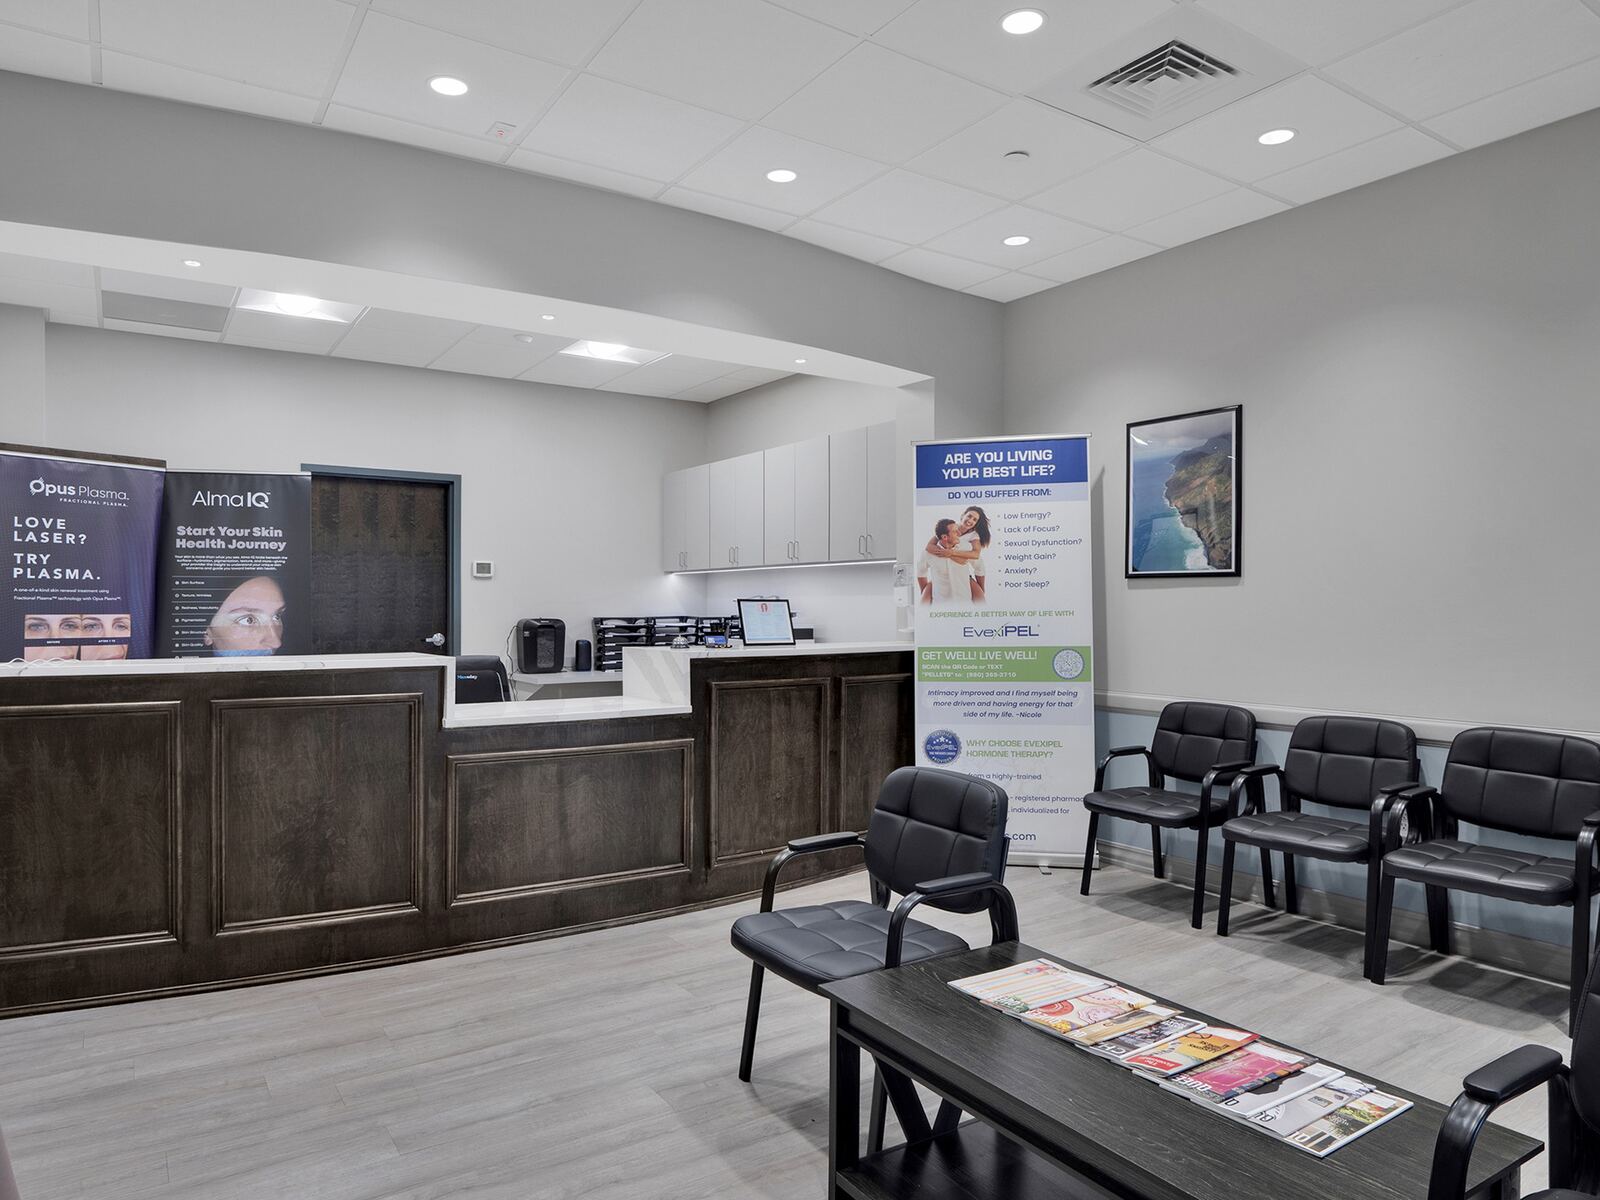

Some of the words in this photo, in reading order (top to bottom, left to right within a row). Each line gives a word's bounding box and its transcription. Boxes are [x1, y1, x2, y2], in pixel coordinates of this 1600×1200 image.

[944, 453, 971, 465] ARE
[975, 452, 1003, 463] YOU
[1007, 449, 1053, 462] LIVING
[942, 468, 979, 480] YOUR
[982, 466, 1017, 478] BEST
[1021, 464, 1056, 477] LIFE?
[29, 477, 76, 497] Opus
[948, 491, 961, 500] DO
[963, 490, 982, 499] YOU
[984, 489, 1020, 498] SUFFER
[1022, 488, 1052, 497] FROM:
[1003, 512, 1018, 520] Low
[1020, 511, 1051, 521] Energy?
[13, 516, 66, 530] LOVE
[176, 525, 215, 536] Start
[218, 526, 250, 537] Your
[252, 526, 283, 538] Skin
[1023, 525, 1031, 533] of
[13, 531, 87, 545] LASER?
[1031, 538, 1082, 548] Dysfunction?
[175, 538, 226, 549] Health
[228, 539, 287, 552] Journey
[13, 552, 51, 565] TRY
[1004, 553, 1032, 562] Weight
[1033, 552, 1057, 561] Gain?
[13, 567, 101, 580] PLASMA.
[1004, 566, 1038, 575] Anxiety?
[1024, 580, 1050, 589] Sleep?
[963, 624, 1039, 638] EvexiPEL
[921, 651, 942, 661] GET
[945, 651, 977, 661] WELL!
[979, 651, 1001, 661] LIVE
[1004, 650, 1038, 661] WELL!
[928, 689, 959, 698] Intimacy
[960, 689, 995, 698] improved
[996, 689, 1010, 697] and
[1015, 689, 1029, 697] find
[1031, 689, 1056, 698] myself
[1057, 690, 1078, 698] being
[952, 699, 975, 707] driven
[995, 700, 1018, 709] having
[1019, 701, 1045, 709] energy
[966, 739, 986, 748] WHY
[988, 739, 1021, 748] CHOOSE
[1023, 740, 1063, 748] EVEXIPEL
[966, 750, 1009, 758] HORMONE
[1010, 750, 1053, 759] THERAPY?
[992, 772, 1042, 780] highly-trained
[1014, 795, 1050, 803] registered
